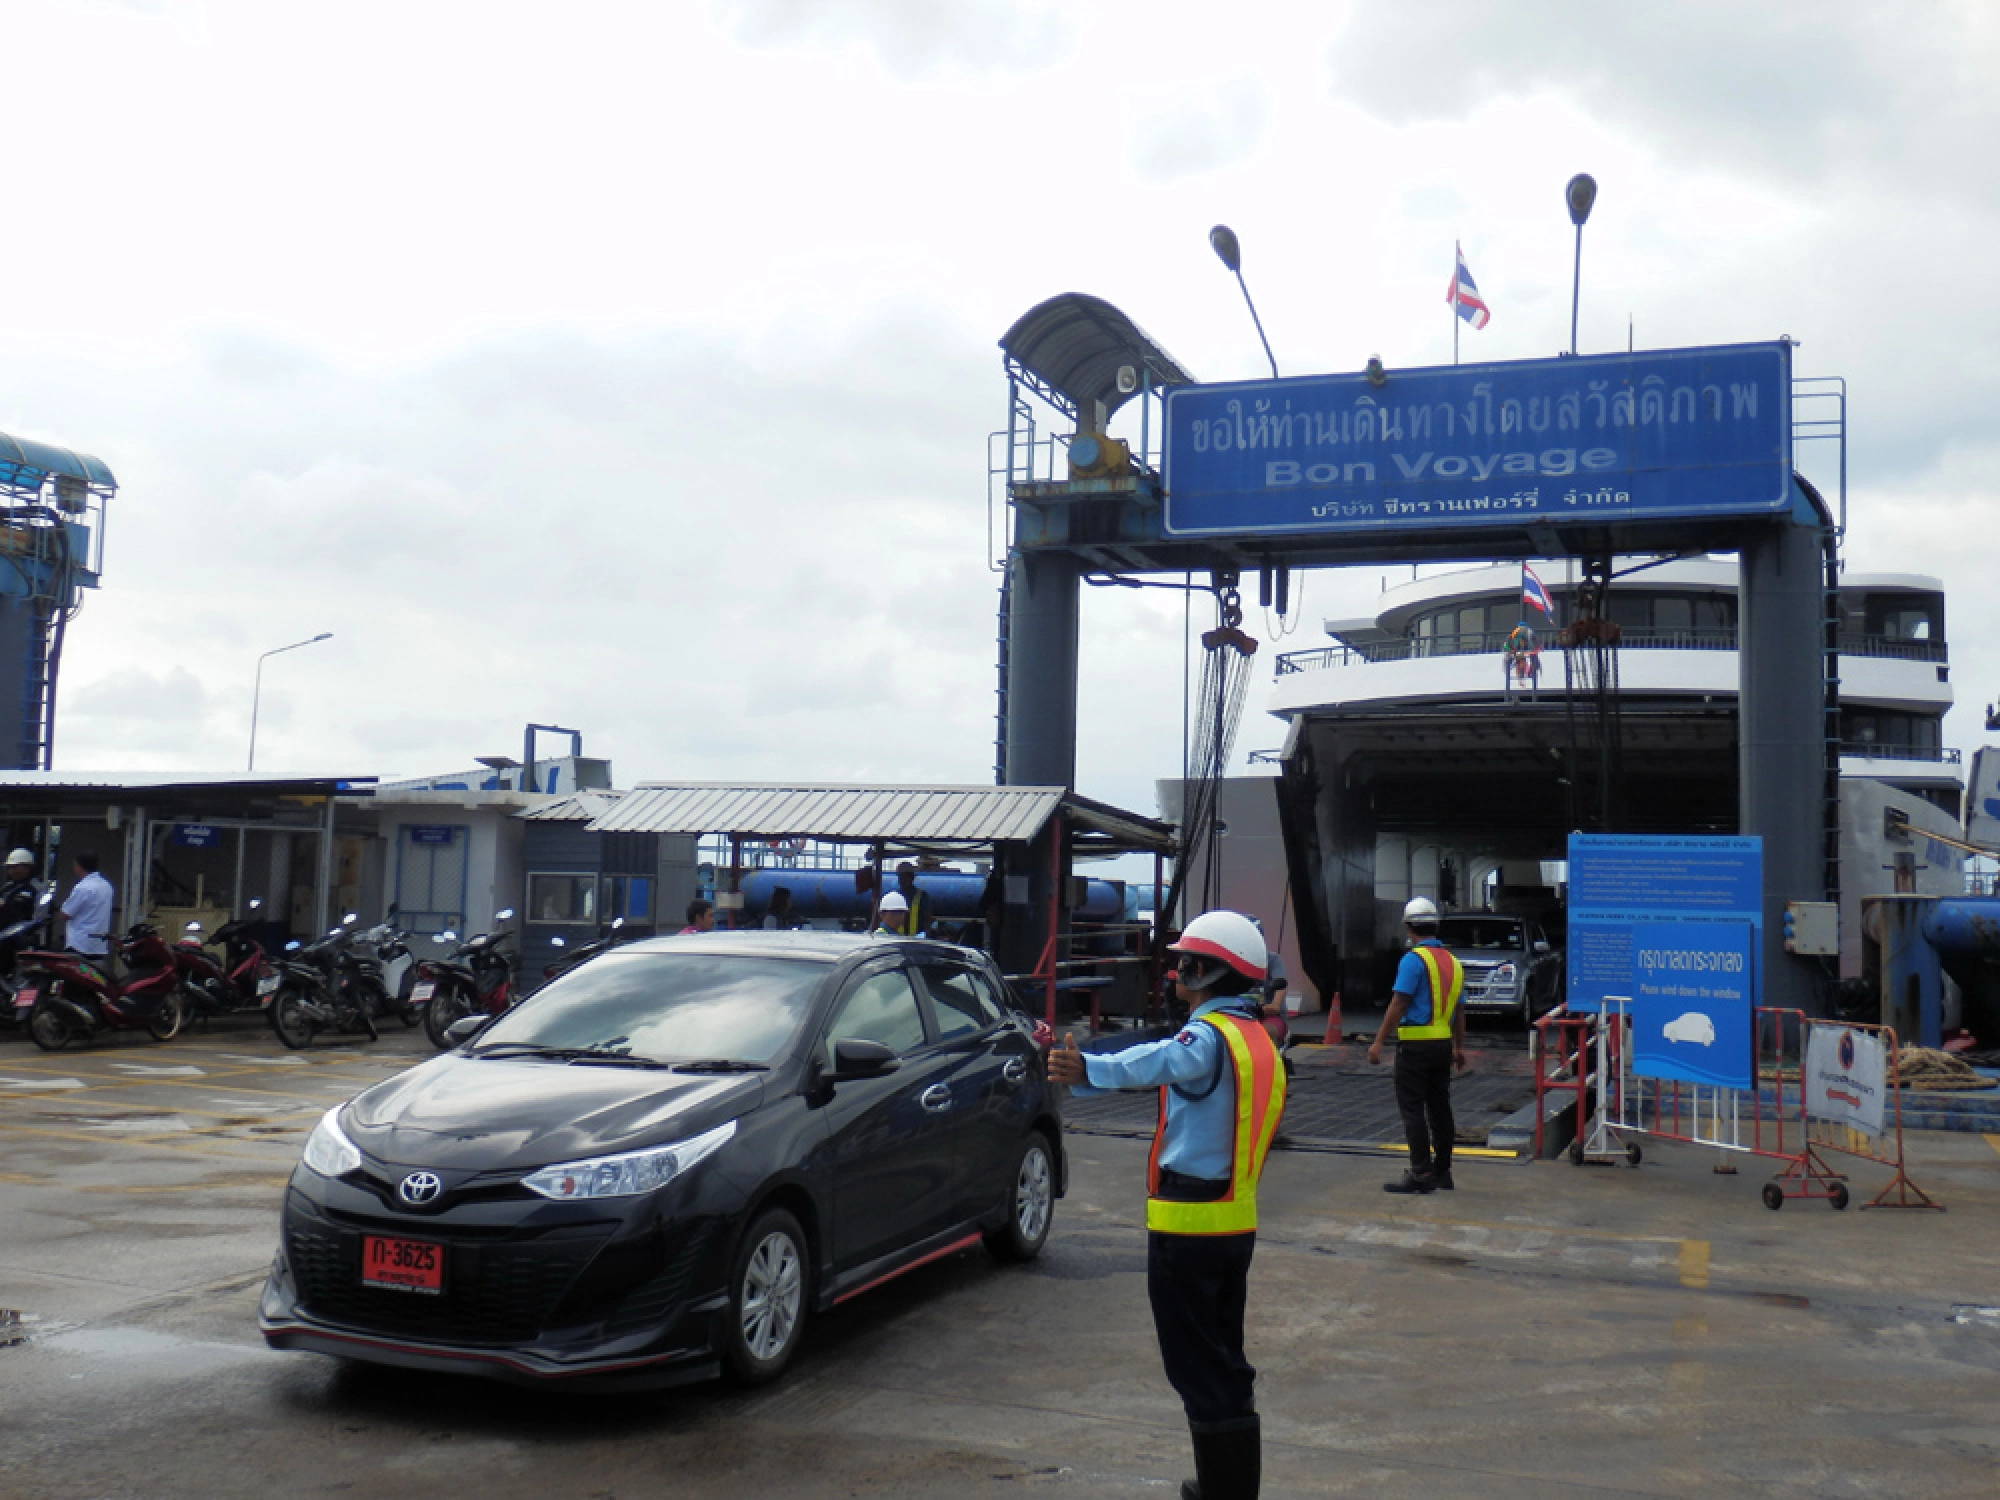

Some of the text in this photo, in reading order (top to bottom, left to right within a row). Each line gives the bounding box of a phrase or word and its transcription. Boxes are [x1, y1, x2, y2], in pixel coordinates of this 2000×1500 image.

[1265, 447, 1618, 487] Bon Voyage
[1311, 499, 1375, 518] บริษัท
[1563, 487, 1631, 506] จำกัด
